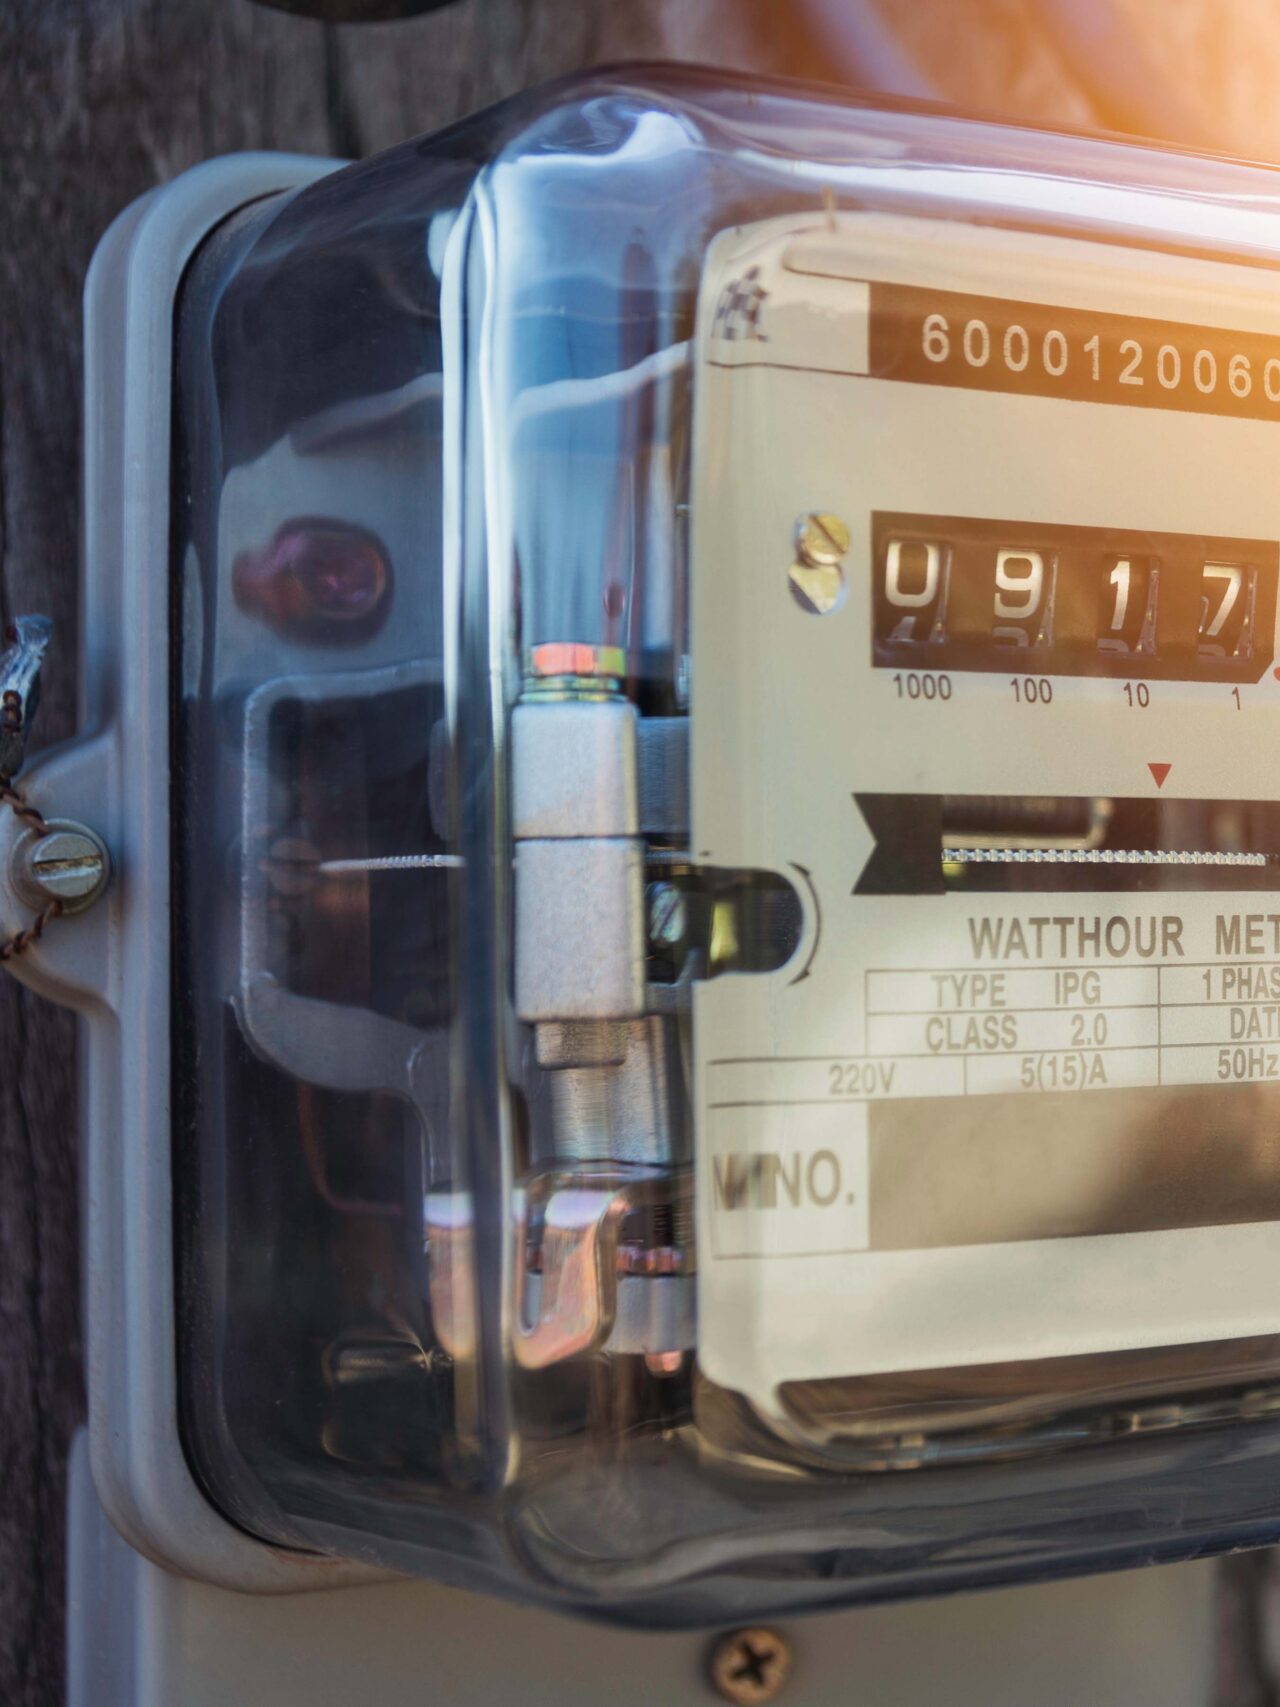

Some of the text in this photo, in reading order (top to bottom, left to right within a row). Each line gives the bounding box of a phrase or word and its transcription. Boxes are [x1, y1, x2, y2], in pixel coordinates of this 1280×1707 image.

[893, 673, 952, 701] 1000
[1010, 677, 1053, 705] 100
[1123, 682, 1150, 708] 10
[1231, 687, 1241, 711] 1
[967, 916, 1185, 960] WATTHOUR
[931, 970, 1102, 1008] TYPE IPG
[1202, 969, 1212, 1000] 1
[925, 1012, 1107, 1053] CLASS 2.0
[828, 1062, 896, 1095] 220V
[1020, 1053, 1108, 1090] 5(15)A
[1217, 1047, 1279, 1080] 50Hz
